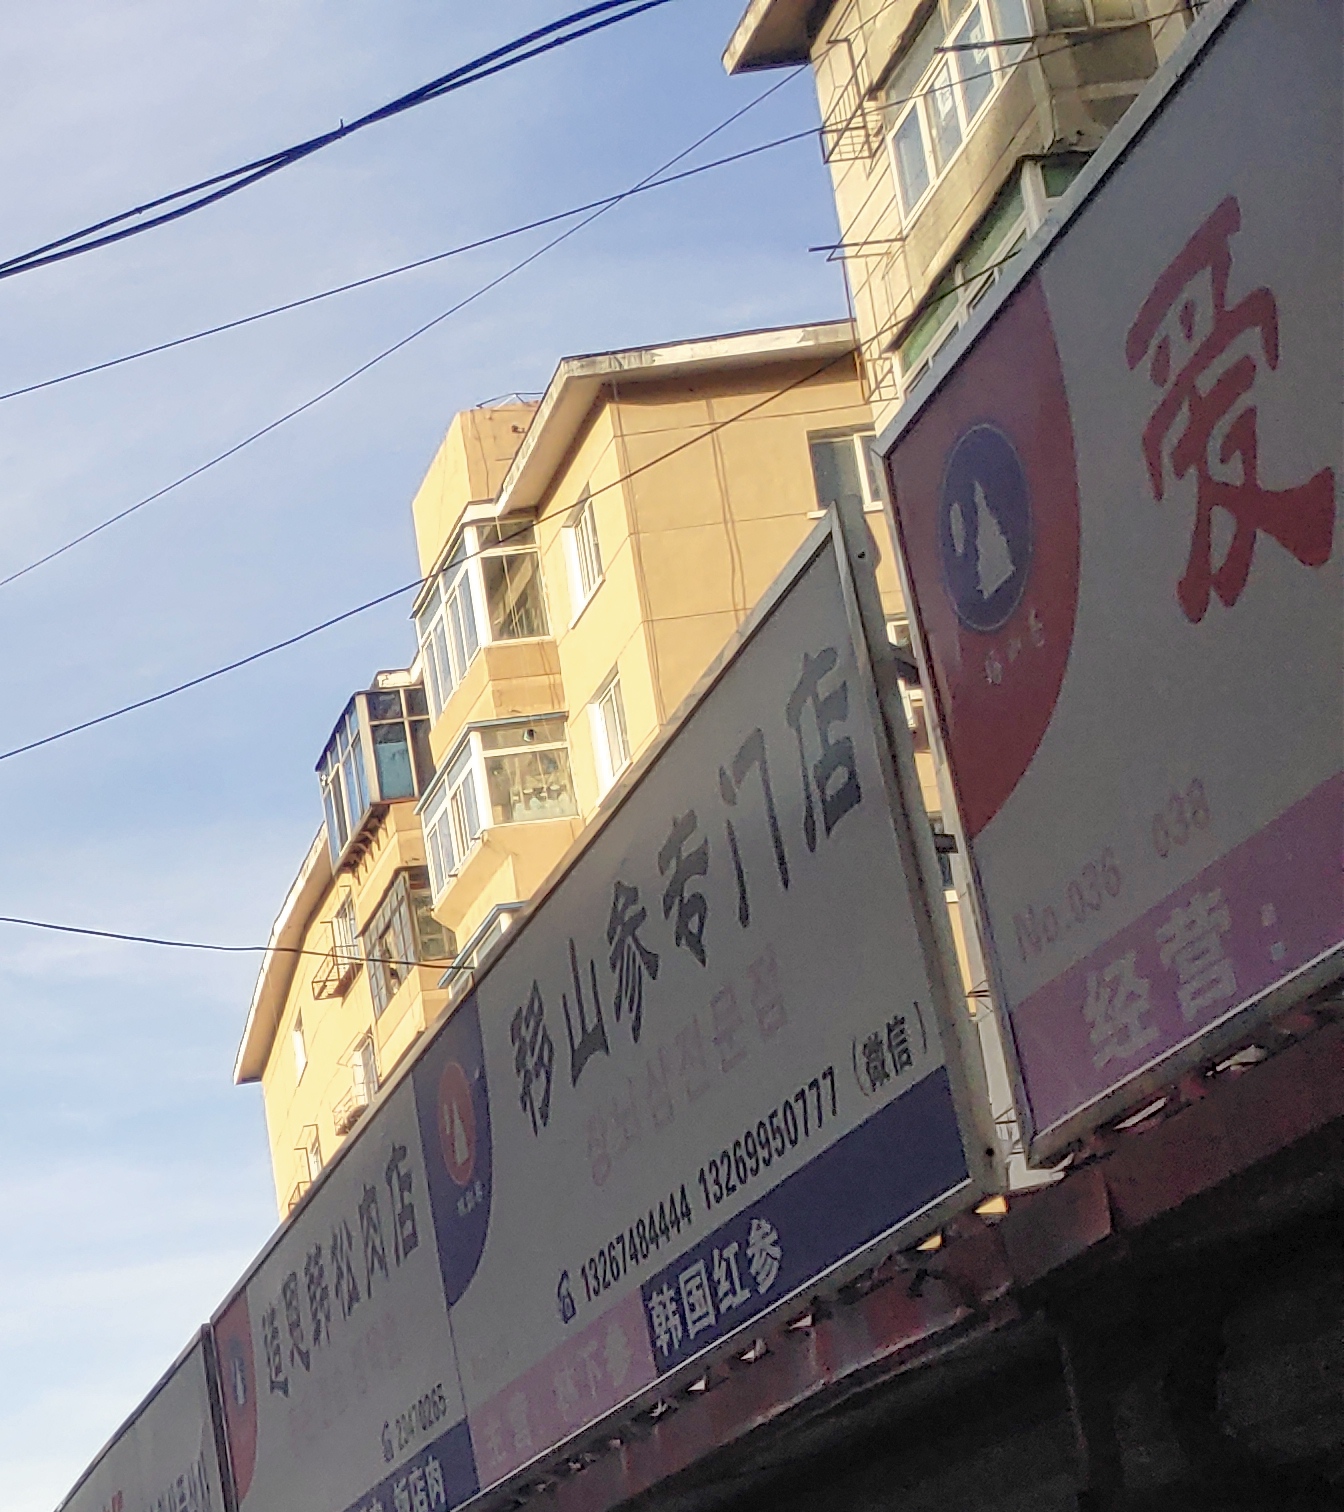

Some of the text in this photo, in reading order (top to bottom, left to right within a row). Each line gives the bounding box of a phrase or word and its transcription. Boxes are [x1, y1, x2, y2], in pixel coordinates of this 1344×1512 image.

[1124, 194, 1336, 624] 爱
[648, 1216, 783, 1357] 韩国红参
